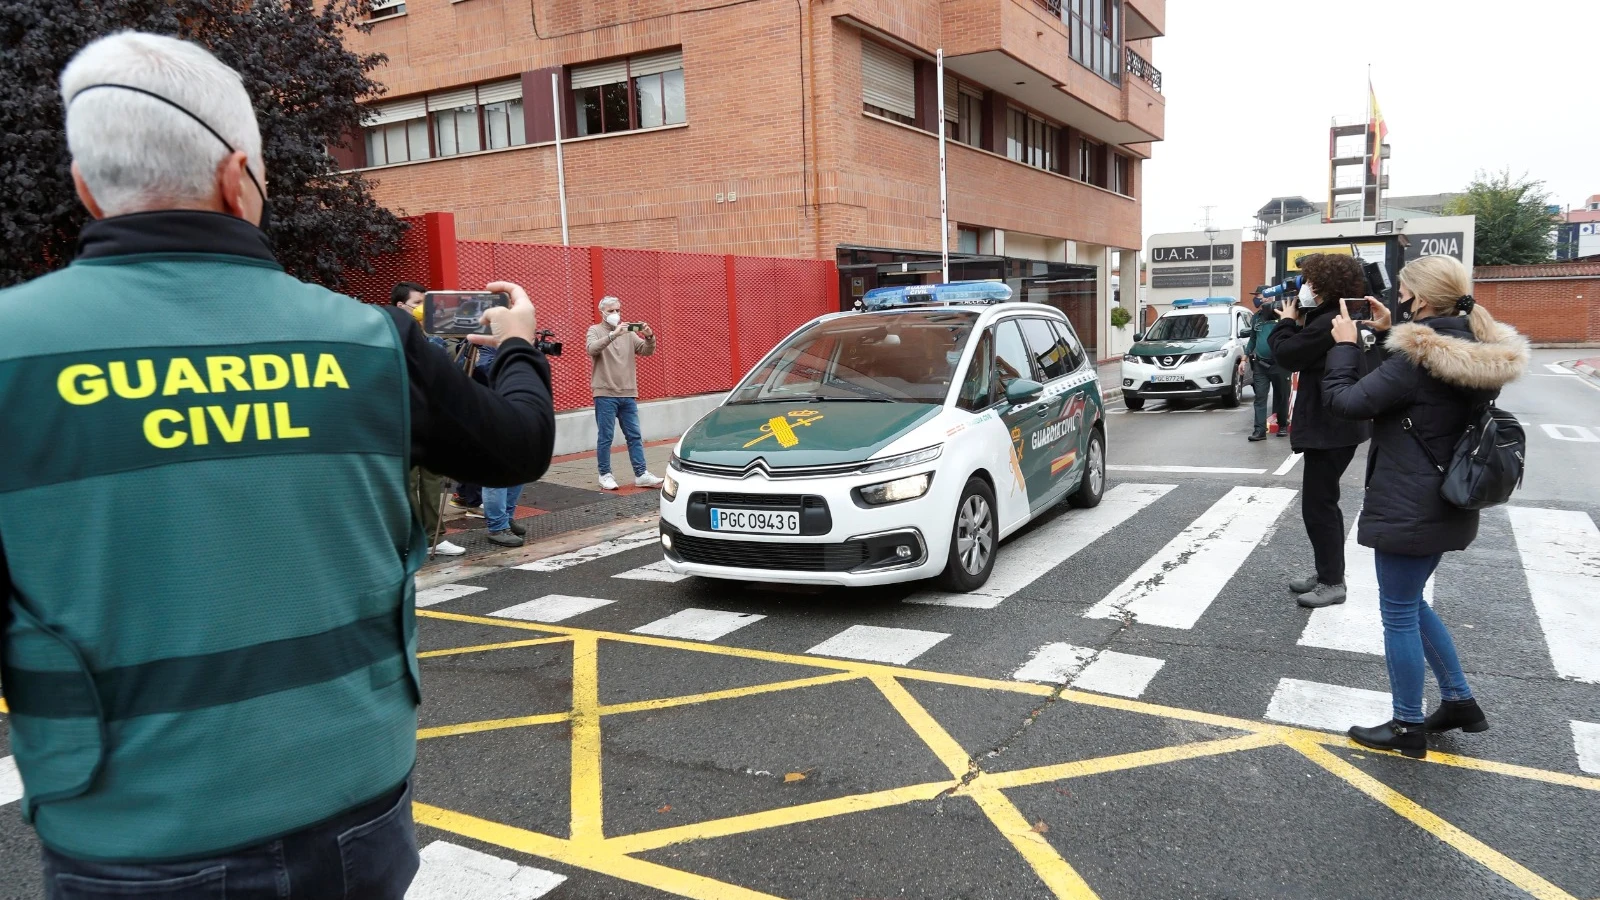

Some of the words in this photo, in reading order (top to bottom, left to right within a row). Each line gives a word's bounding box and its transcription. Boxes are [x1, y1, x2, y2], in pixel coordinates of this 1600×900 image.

[1154, 247, 1199, 261] U.A.R.
[1420, 237, 1459, 256] ZONA
[57, 353, 349, 405] GUARDIA
[143, 402, 310, 448] CIVIL
[1031, 421, 1061, 450] GUARDIA
[720, 511, 746, 528] PGC
[748, 513, 784, 530] 0943
[787, 515, 797, 530] G
